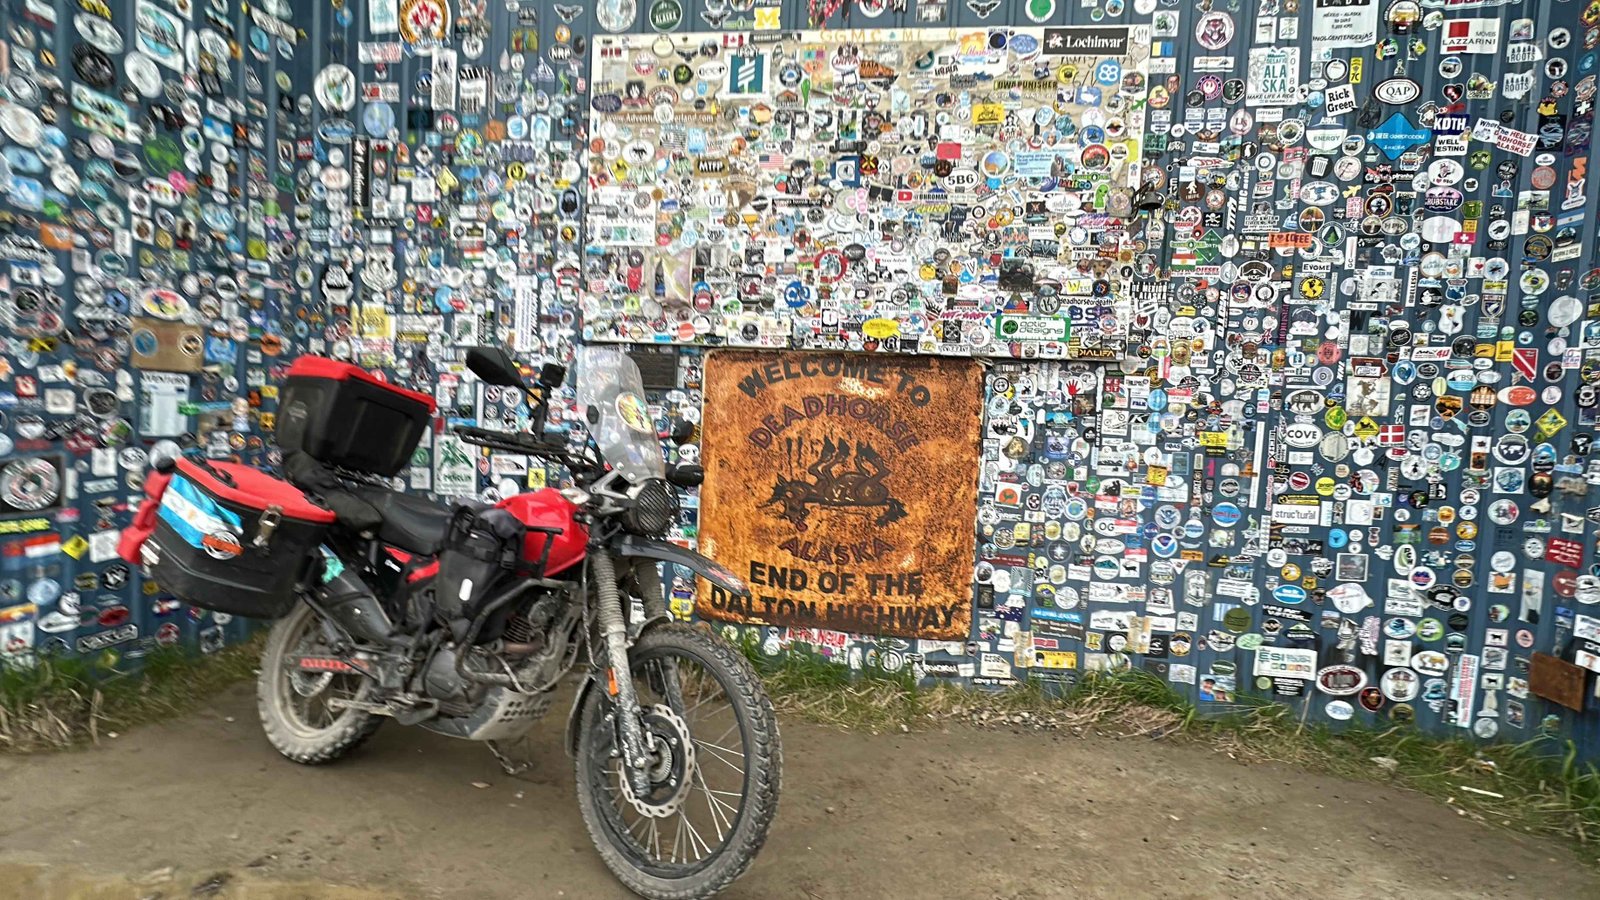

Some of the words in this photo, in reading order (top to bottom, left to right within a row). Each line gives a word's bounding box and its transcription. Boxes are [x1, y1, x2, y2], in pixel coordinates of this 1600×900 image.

[1066, 34, 1125, 49] Lochinvar
[1442, 37, 1496, 46] LAZZARINI
[1510, 50, 1536, 62] ROOTS
[1264, 65, 1287, 79] ALA
[1262, 79, 1287, 92] SKA
[1386, 86, 1411, 96] QAP
[1504, 81, 1529, 92] ROOTS
[1328, 88, 1350, 102] Rick
[1327, 100, 1354, 113] Green
[1510, 131, 1528, 141] HELL
[948, 174, 975, 185] 5B6
[1019, 326, 1063, 335] designs
[737, 356, 887, 399] WELCOME
[896, 372, 931, 408] TO
[749, 394, 920, 452] DEADHORSE
[1287, 430, 1317, 439] COVE
[779, 537, 895, 566] ALASKA
[750, 560, 807, 593] END
[818, 571, 856, 595] OF
[867, 571, 923, 597] THE
[711, 583, 815, 622] DALTON
[826, 600, 959, 631] HIGHWAY
[1259, 652, 1285, 661] ESI
